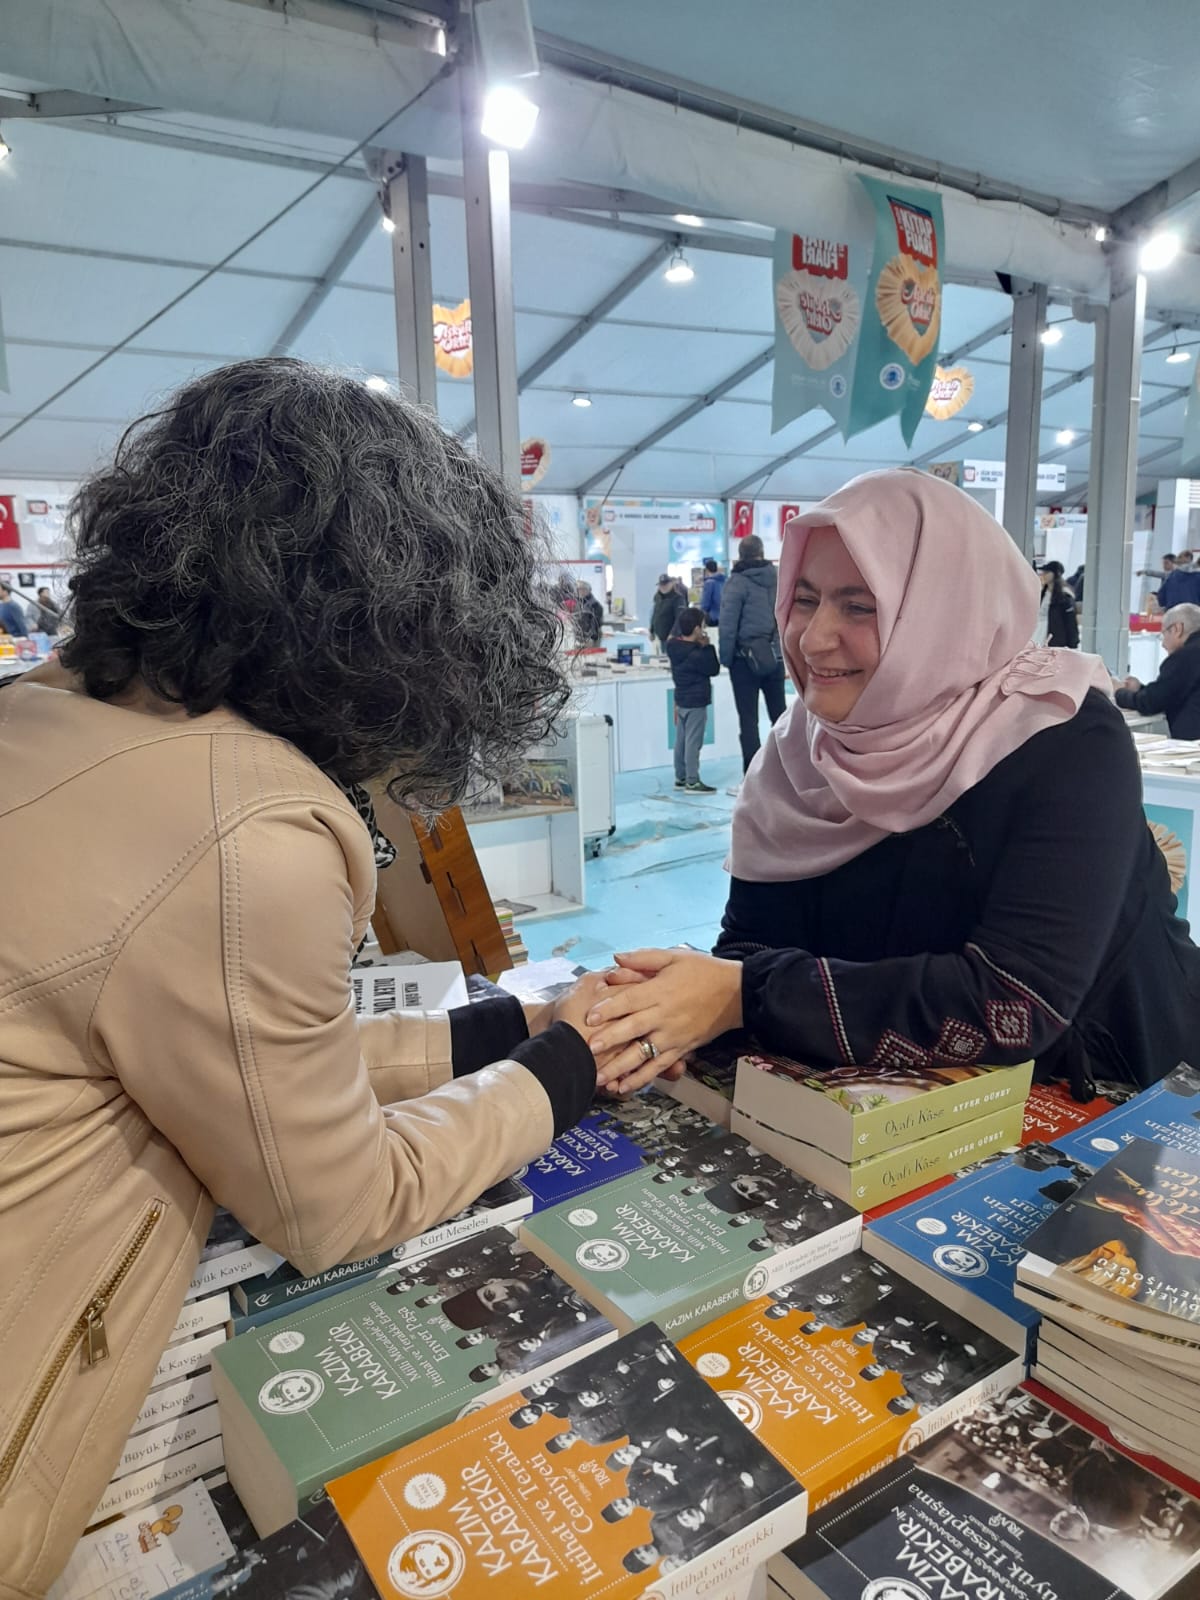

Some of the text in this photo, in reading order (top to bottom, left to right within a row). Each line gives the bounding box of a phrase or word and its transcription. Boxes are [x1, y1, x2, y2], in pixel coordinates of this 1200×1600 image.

[373, 999, 396, 1014] TUN
[952, 1096, 981, 1113] AYFER
[570, 1125, 619, 1162] Davamı
[948, 1141, 975, 1159] AYFER
[419, 1215, 490, 1249] Kürt Meselesi
[611, 1222, 664, 1260] KAZIM
[615, 1203, 696, 1263] KARABEKİR
[692, 1211, 727, 1238] Enver
[951, 1211, 1024, 1256] RABEKİR
[956, 1228, 1019, 1267] KAZIM
[189, 1260, 253, 1290] üyük Kavga
[286, 1255, 380, 1297] KAZIM KARABEKİR
[1092, 1264, 1138, 1290] TUNA
[665, 1287, 741, 1331] KAZIM KARABEKİR
[385, 1319, 416, 1352] Terakki
[397, 1306, 450, 1363] Enver Paşa
[410, 1348, 423, 1361] ve
[748, 1320, 804, 1367] Terakki
[168, 1352, 203, 1372] Kavga
[314, 1344, 364, 1397] KAZIM
[327, 1320, 402, 1400] KARABEKİR
[398, 1359, 421, 1383] Milli
[418, 1359, 446, 1388] İttihat
[791, 1334, 857, 1389] Cemiyeti
[804, 1363, 823, 1382] ve
[736, 1366, 800, 1419] KAZIM
[738, 1341, 839, 1425] KARABEKİR
[823, 1382, 875, 1425] İttihat
[137, 1393, 195, 1423] yük Kavga
[123, 1427, 198, 1465] Büyük Kavga
[125, 1477, 160, 1501] Büyük
[163, 1461, 198, 1482] Kavga
[525, 1451, 594, 1534] Cemiyeti
[461, 1460, 560, 1587] KARABEKİR
[483, 1429, 604, 1585] İttihat ve Terakki
[448, 1496, 513, 1577] KAZIM
[891, 1505, 1003, 1600] RABEKİR'İN
[907, 1483, 1060, 1600] üyük Hesaplaşma
[670, 1523, 776, 1597] İttihat ve Terakki
[695, 1553, 752, 1596] Cemiyeti
[896, 1543, 970, 1600] AZIM
